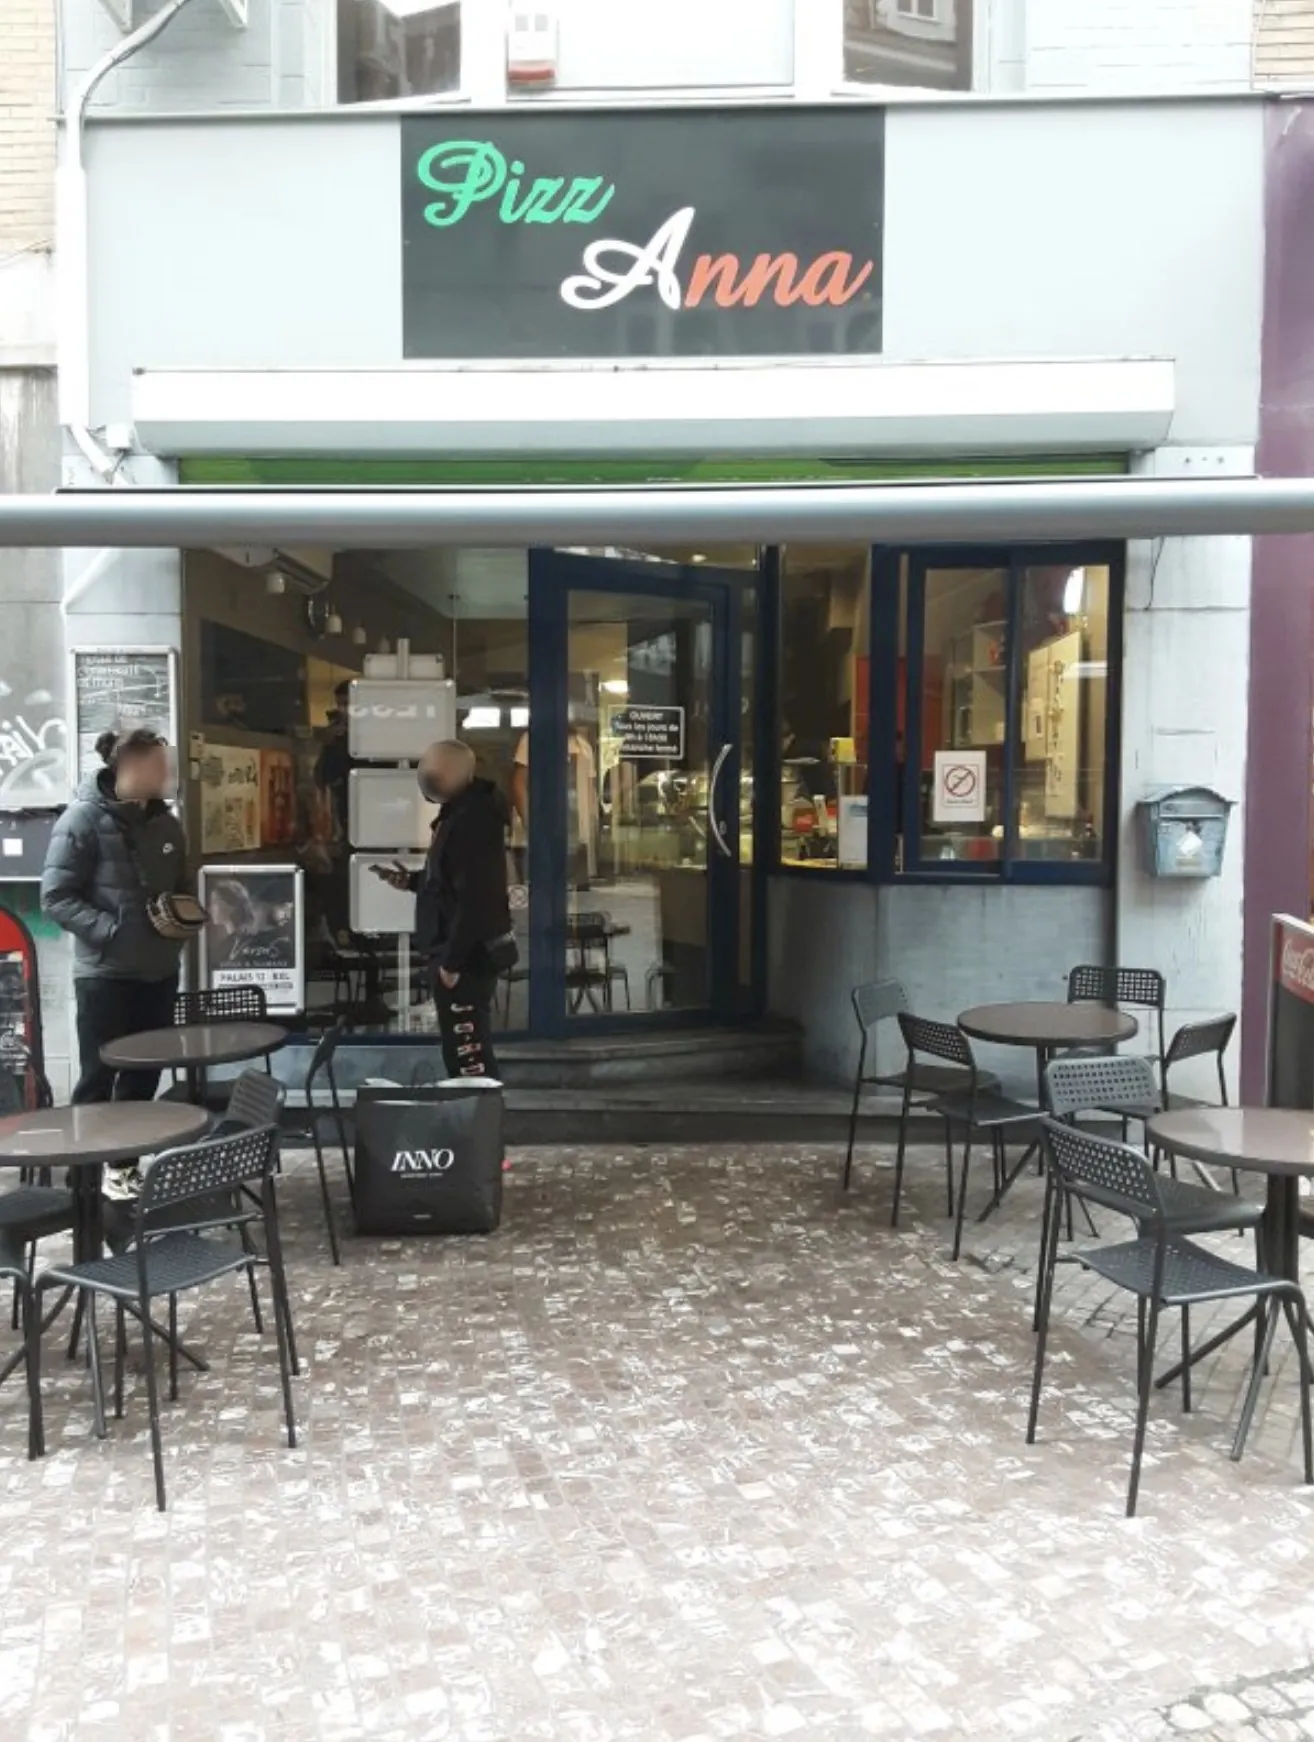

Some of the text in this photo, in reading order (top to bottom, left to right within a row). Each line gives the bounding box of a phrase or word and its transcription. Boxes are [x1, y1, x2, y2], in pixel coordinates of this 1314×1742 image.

[417, 139, 615, 227] Pizz
[560, 206, 873, 310] Anna
[390, 1148, 455, 1173] INNO
